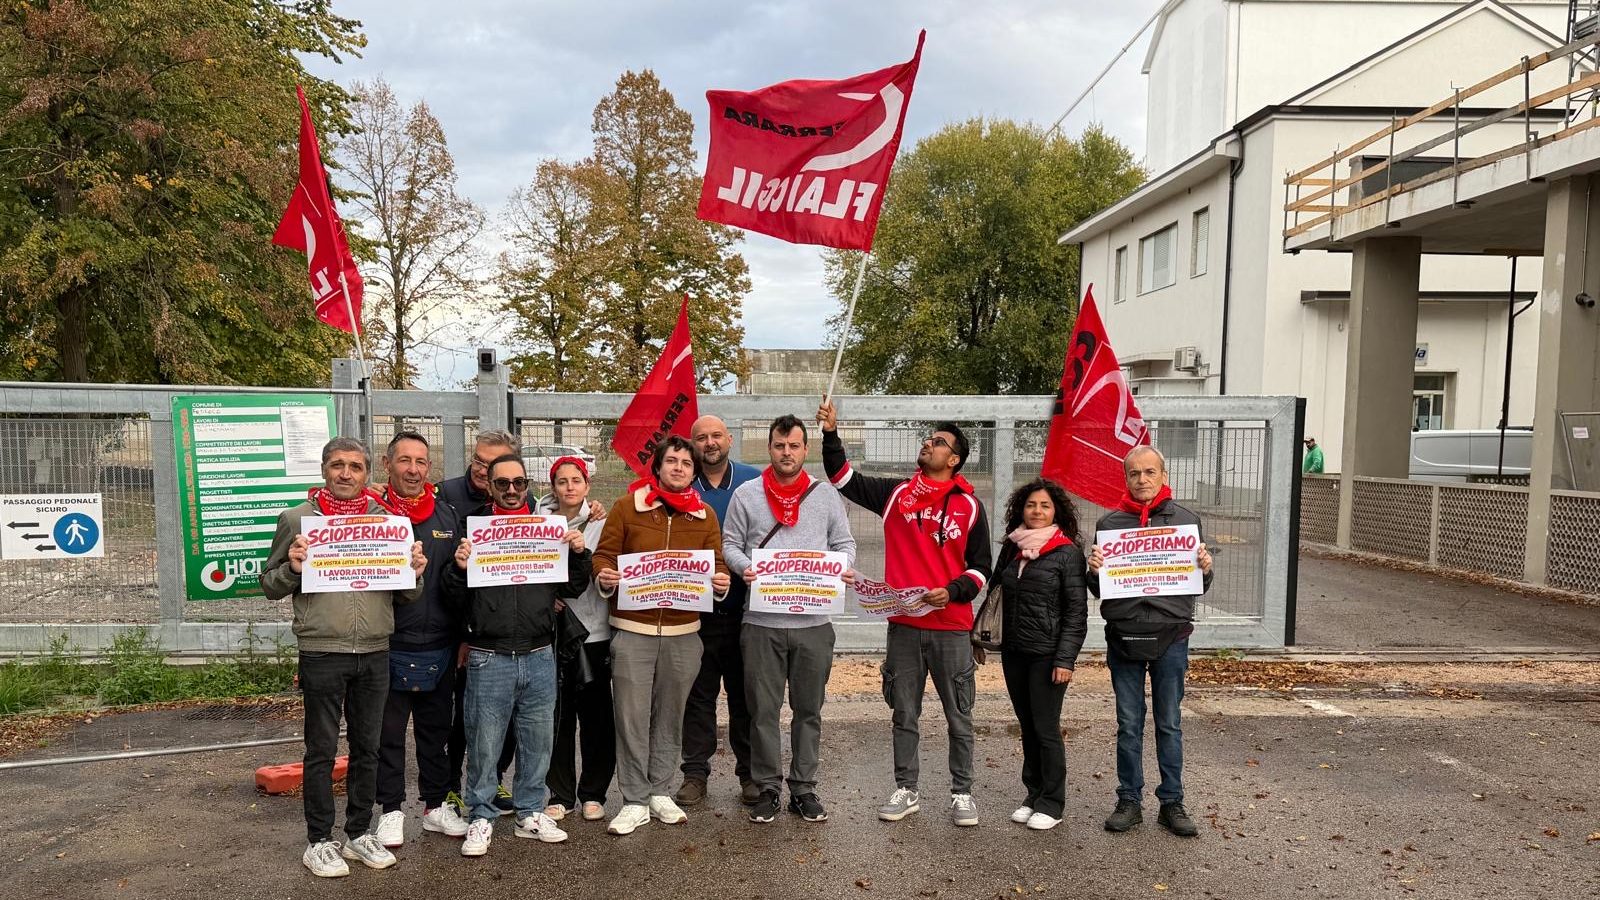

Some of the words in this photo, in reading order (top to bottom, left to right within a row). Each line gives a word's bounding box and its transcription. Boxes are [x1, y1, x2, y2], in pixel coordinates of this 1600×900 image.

[307, 526, 409, 545] SCIOPERIAMO
[472, 526, 564, 543] SCIOPERIAMO
[1103, 535, 1196, 557] SCIOPERIAMO
[486, 564, 532, 572] LAVORATORI
[623, 559, 710, 579] SCIOPERIAMO
[756, 559, 842, 575] SCIOPERIAMO
[1118, 576, 1165, 584] LAVORATORI
[636, 591, 678, 600] LAVORATORI
[854, 581, 925, 599] SCIOPEAMO
